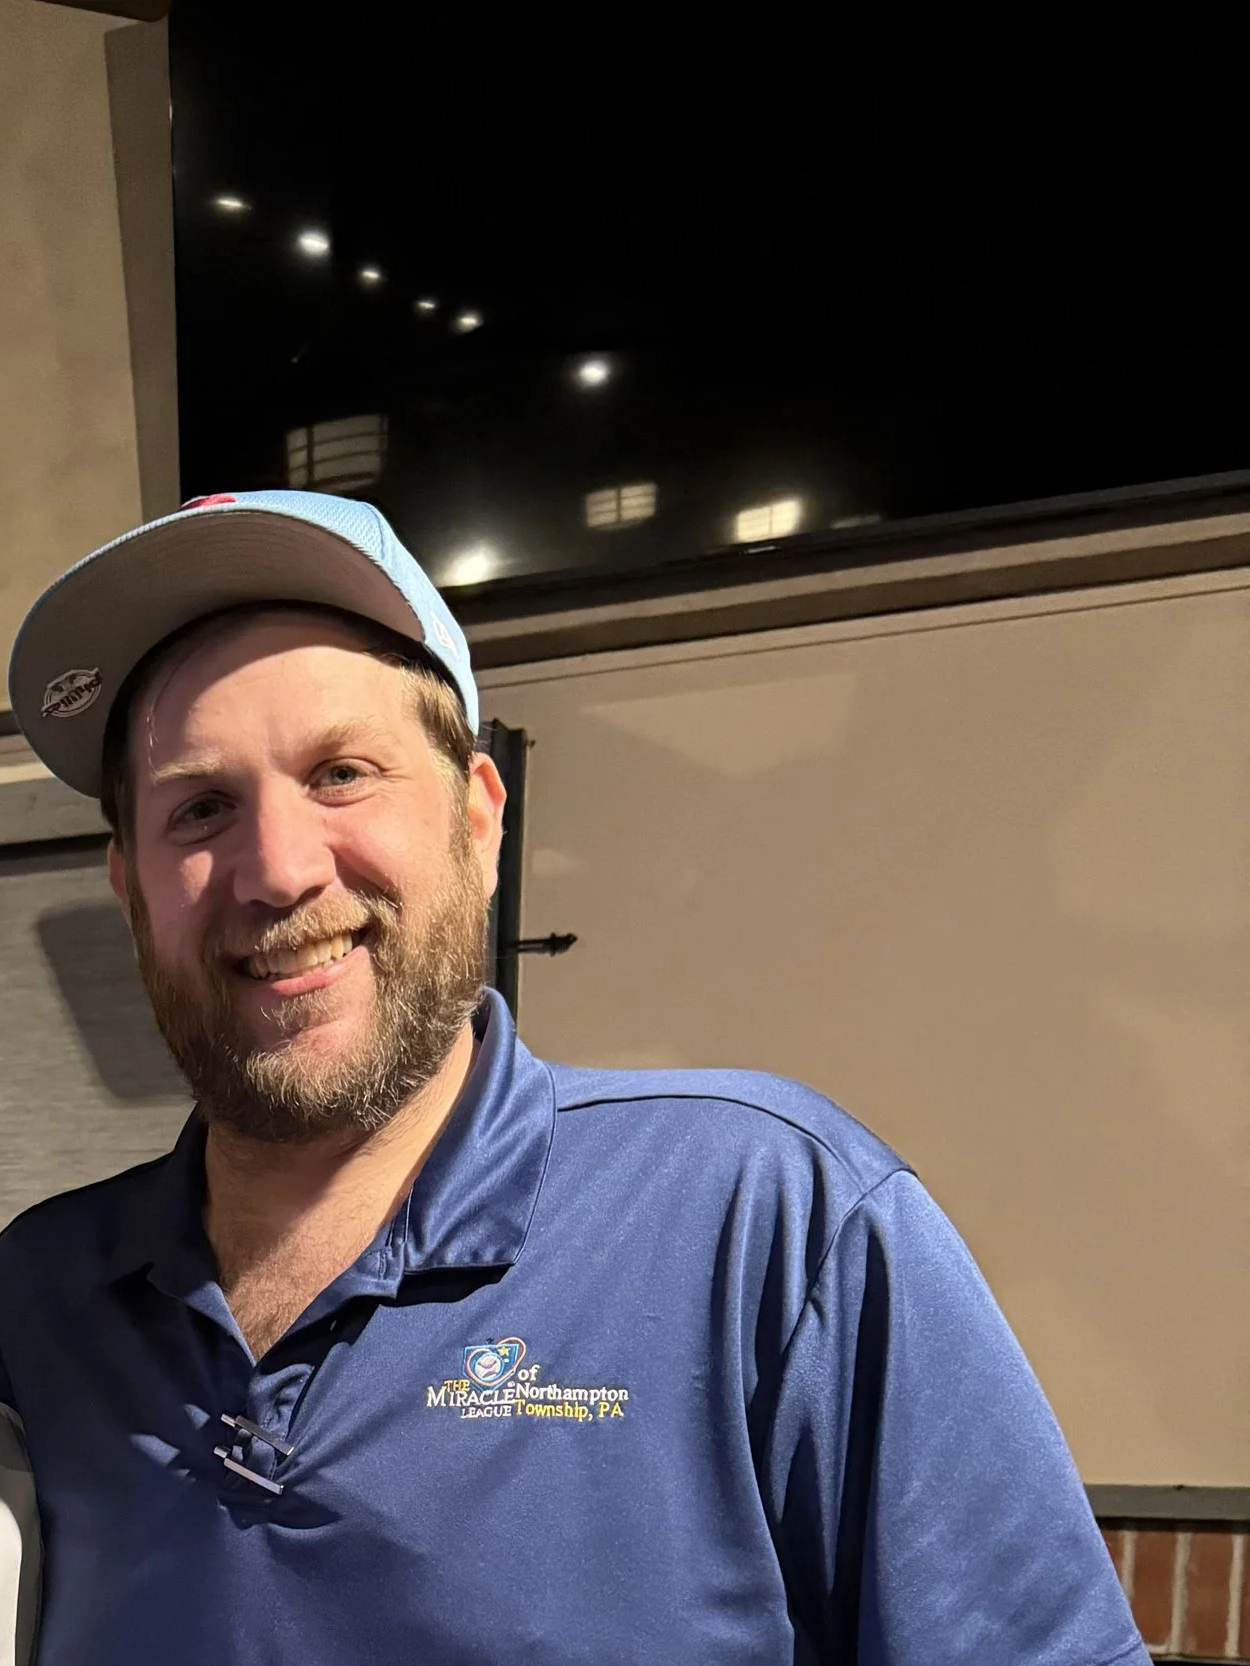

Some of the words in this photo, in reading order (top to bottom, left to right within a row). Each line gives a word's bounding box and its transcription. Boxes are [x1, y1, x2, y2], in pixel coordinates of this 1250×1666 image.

[517, 1364, 540, 1381] of
[426, 1385, 516, 1407] MIRACLE
[515, 1382, 629, 1405] Northampton
[443, 1380, 471, 1393] THE
[460, 1405, 512, 1419] LEAGUE
[514, 1398, 593, 1422] Township,
[598, 1401, 625, 1418] PA
